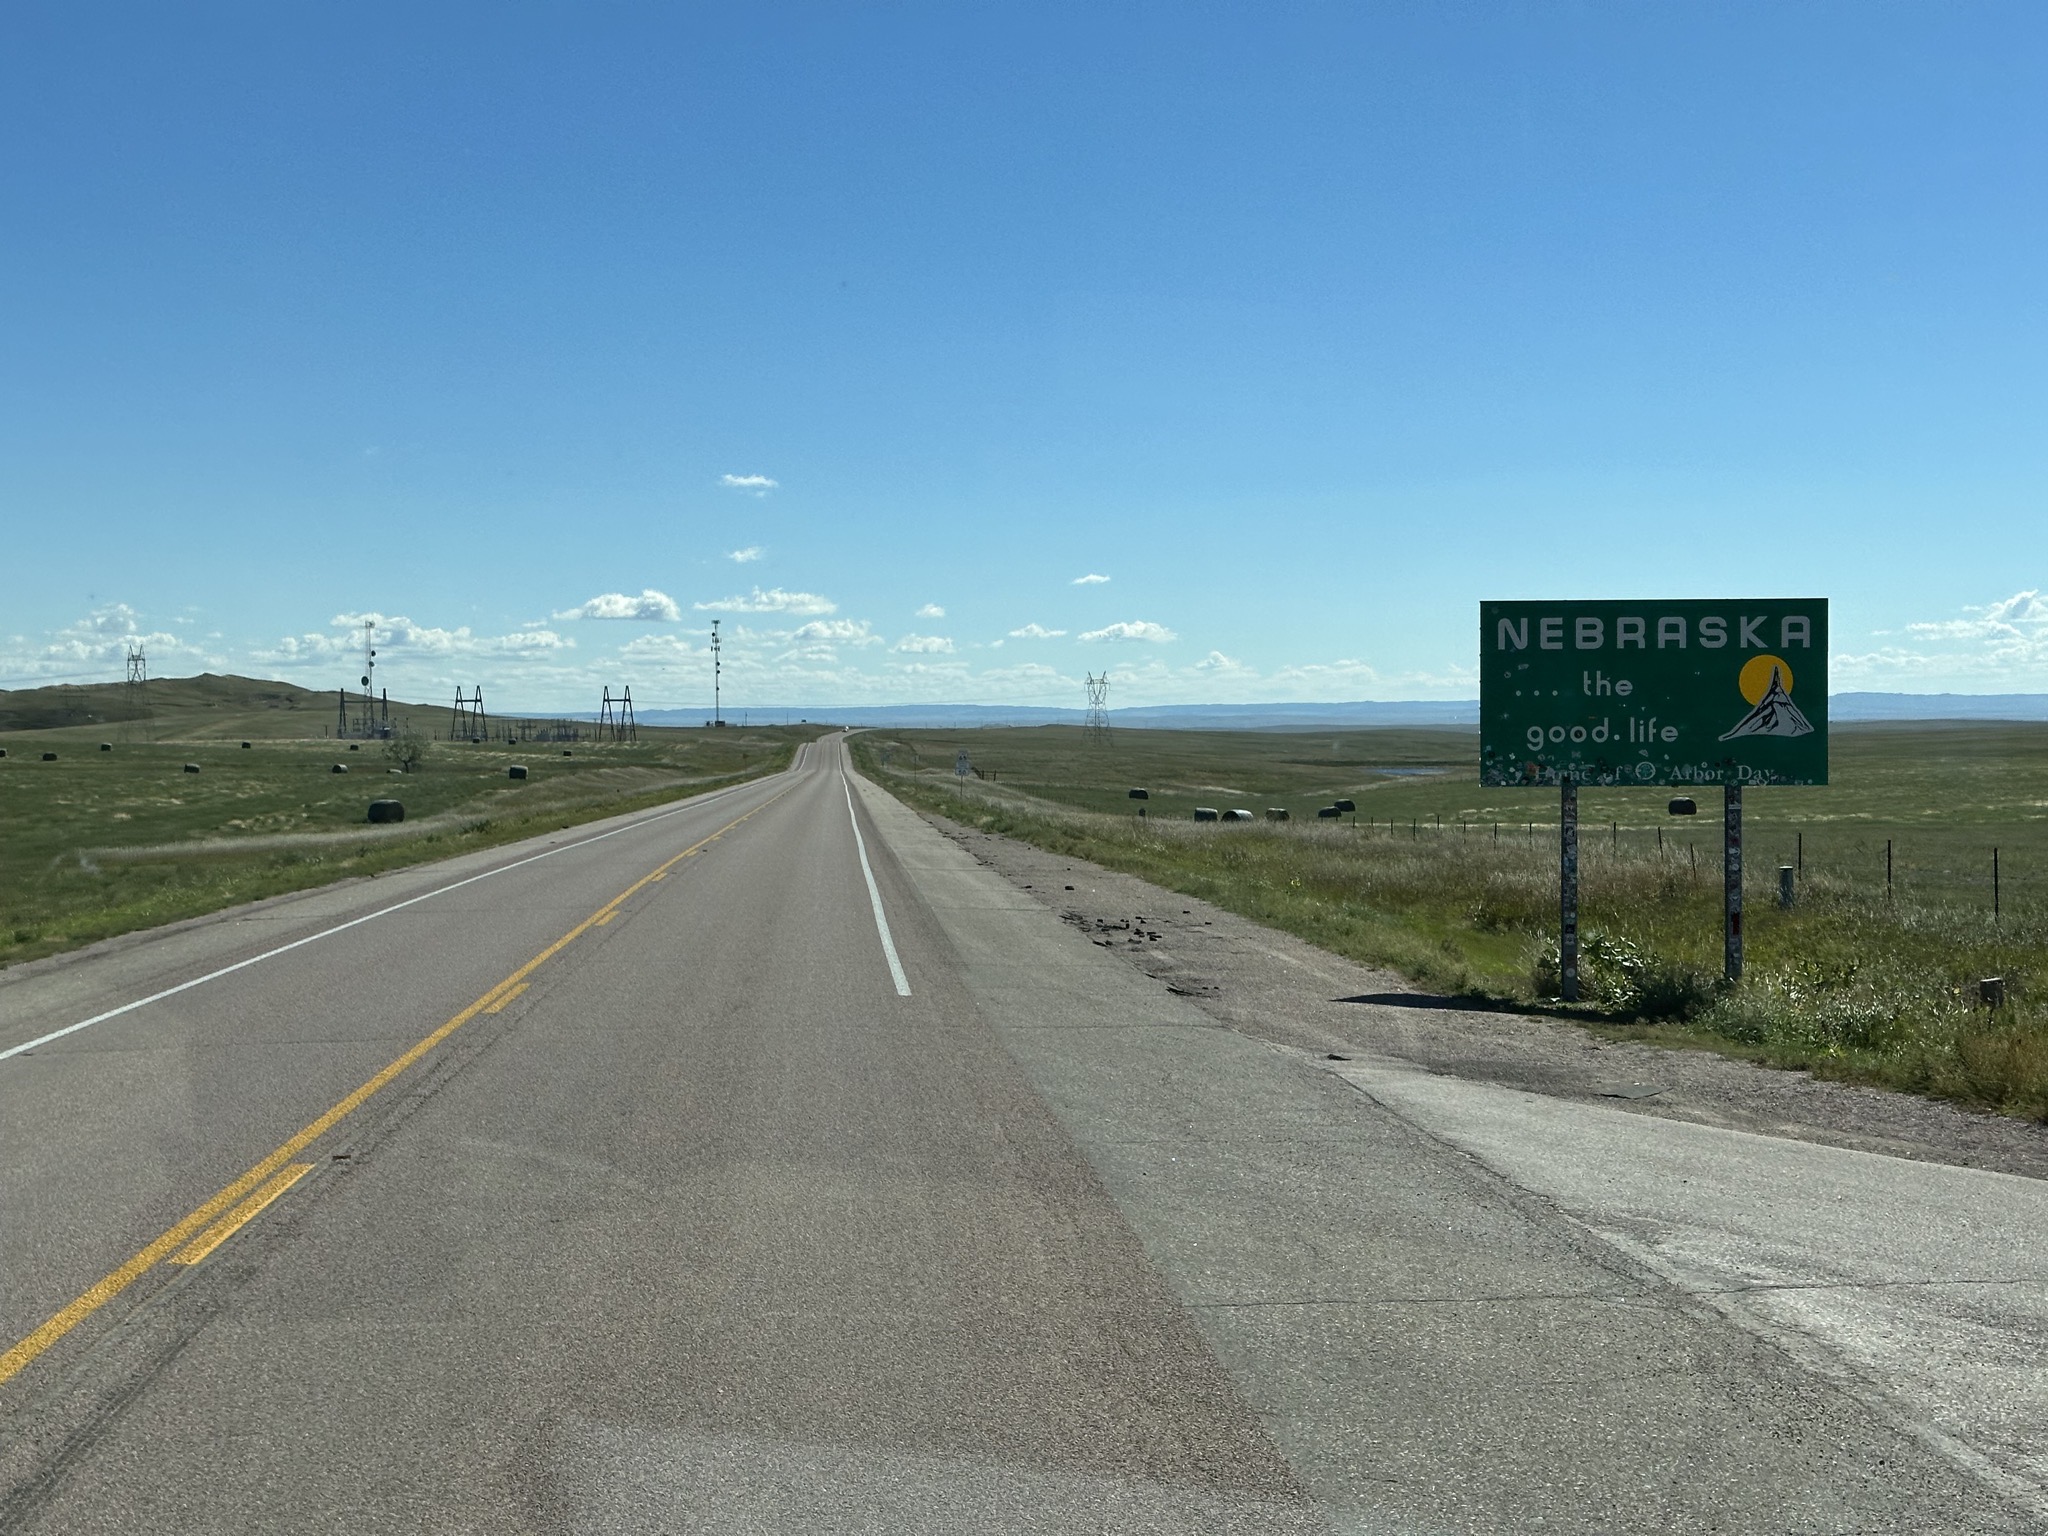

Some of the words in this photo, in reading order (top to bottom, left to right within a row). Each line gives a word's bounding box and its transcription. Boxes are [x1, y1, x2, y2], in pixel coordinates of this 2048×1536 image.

[1498, 615, 1811, 650] NEBRASKA
[1583, 671, 1633, 696] the
[1630, 717, 1679, 742] life
[1669, 765, 1724, 781] Arbor
[1736, 765, 1775, 784] Day
